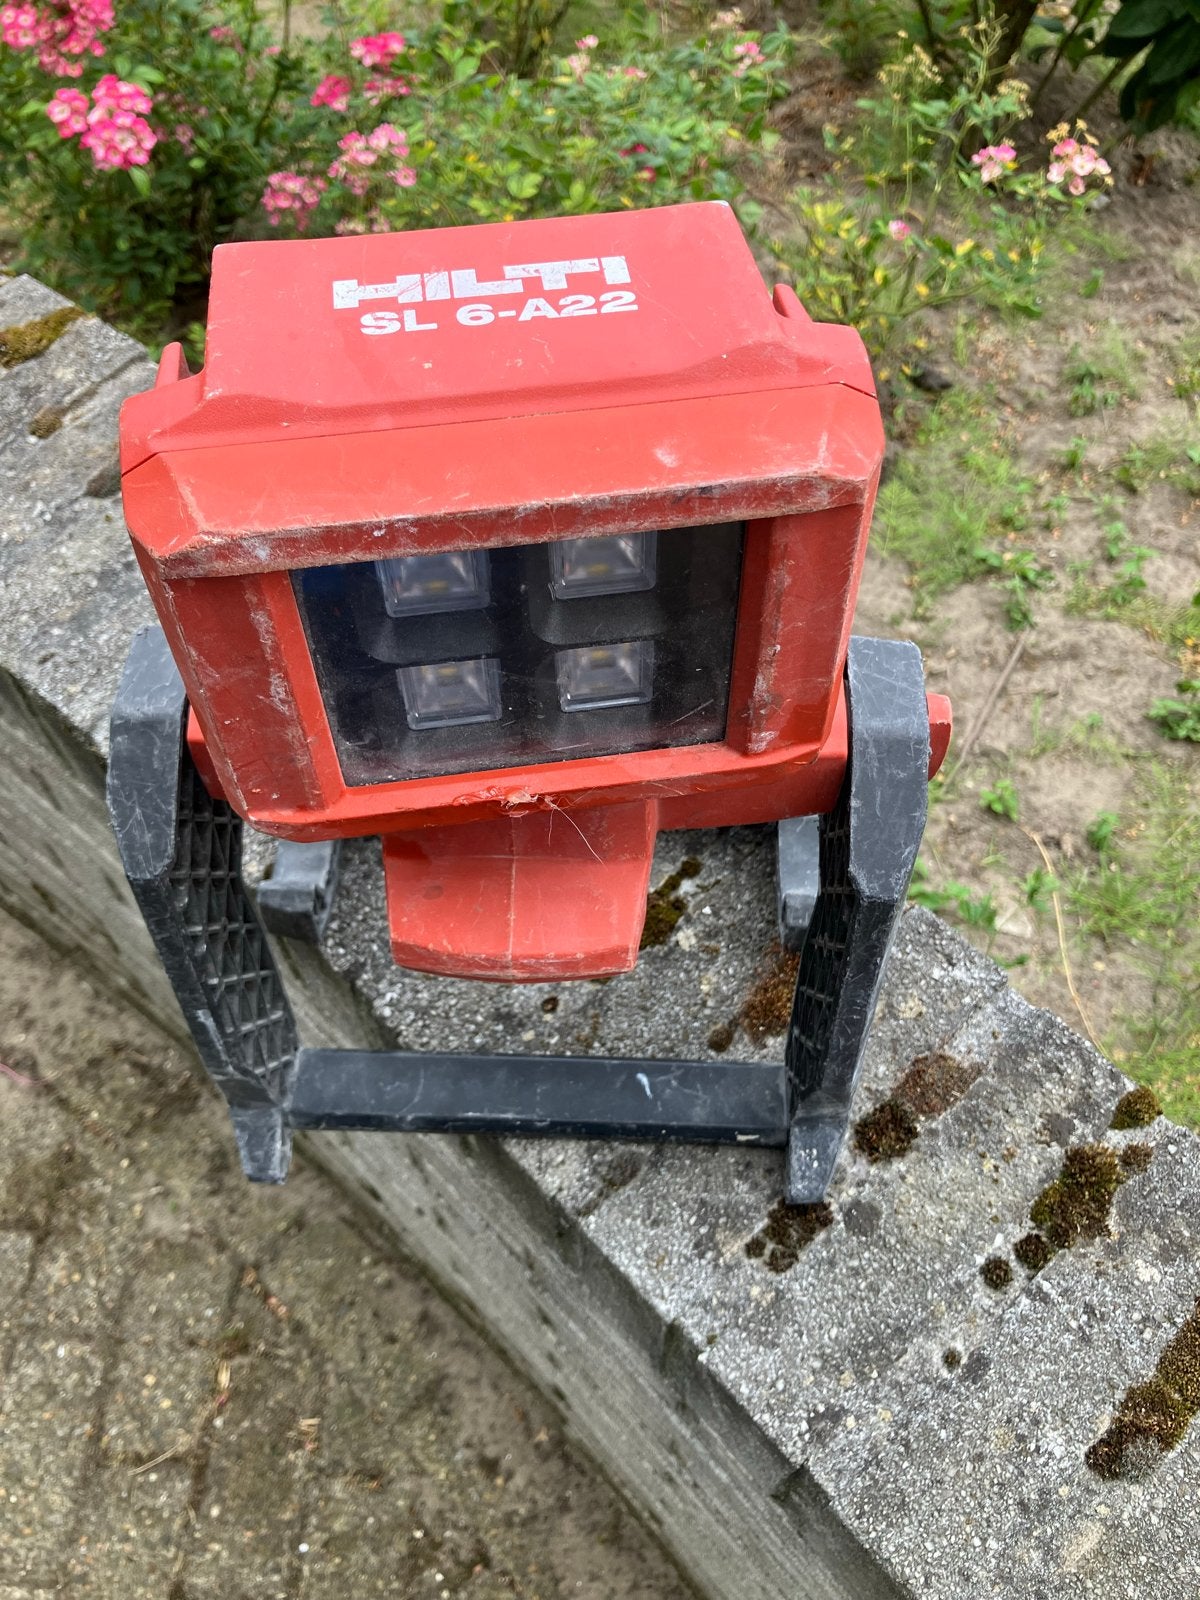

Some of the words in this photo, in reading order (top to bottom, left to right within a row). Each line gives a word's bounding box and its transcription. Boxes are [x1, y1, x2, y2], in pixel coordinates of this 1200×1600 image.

[332, 256, 631, 309] HILTI
[360, 309, 438, 335] SL
[456, 290, 639, 326] 6-A22
